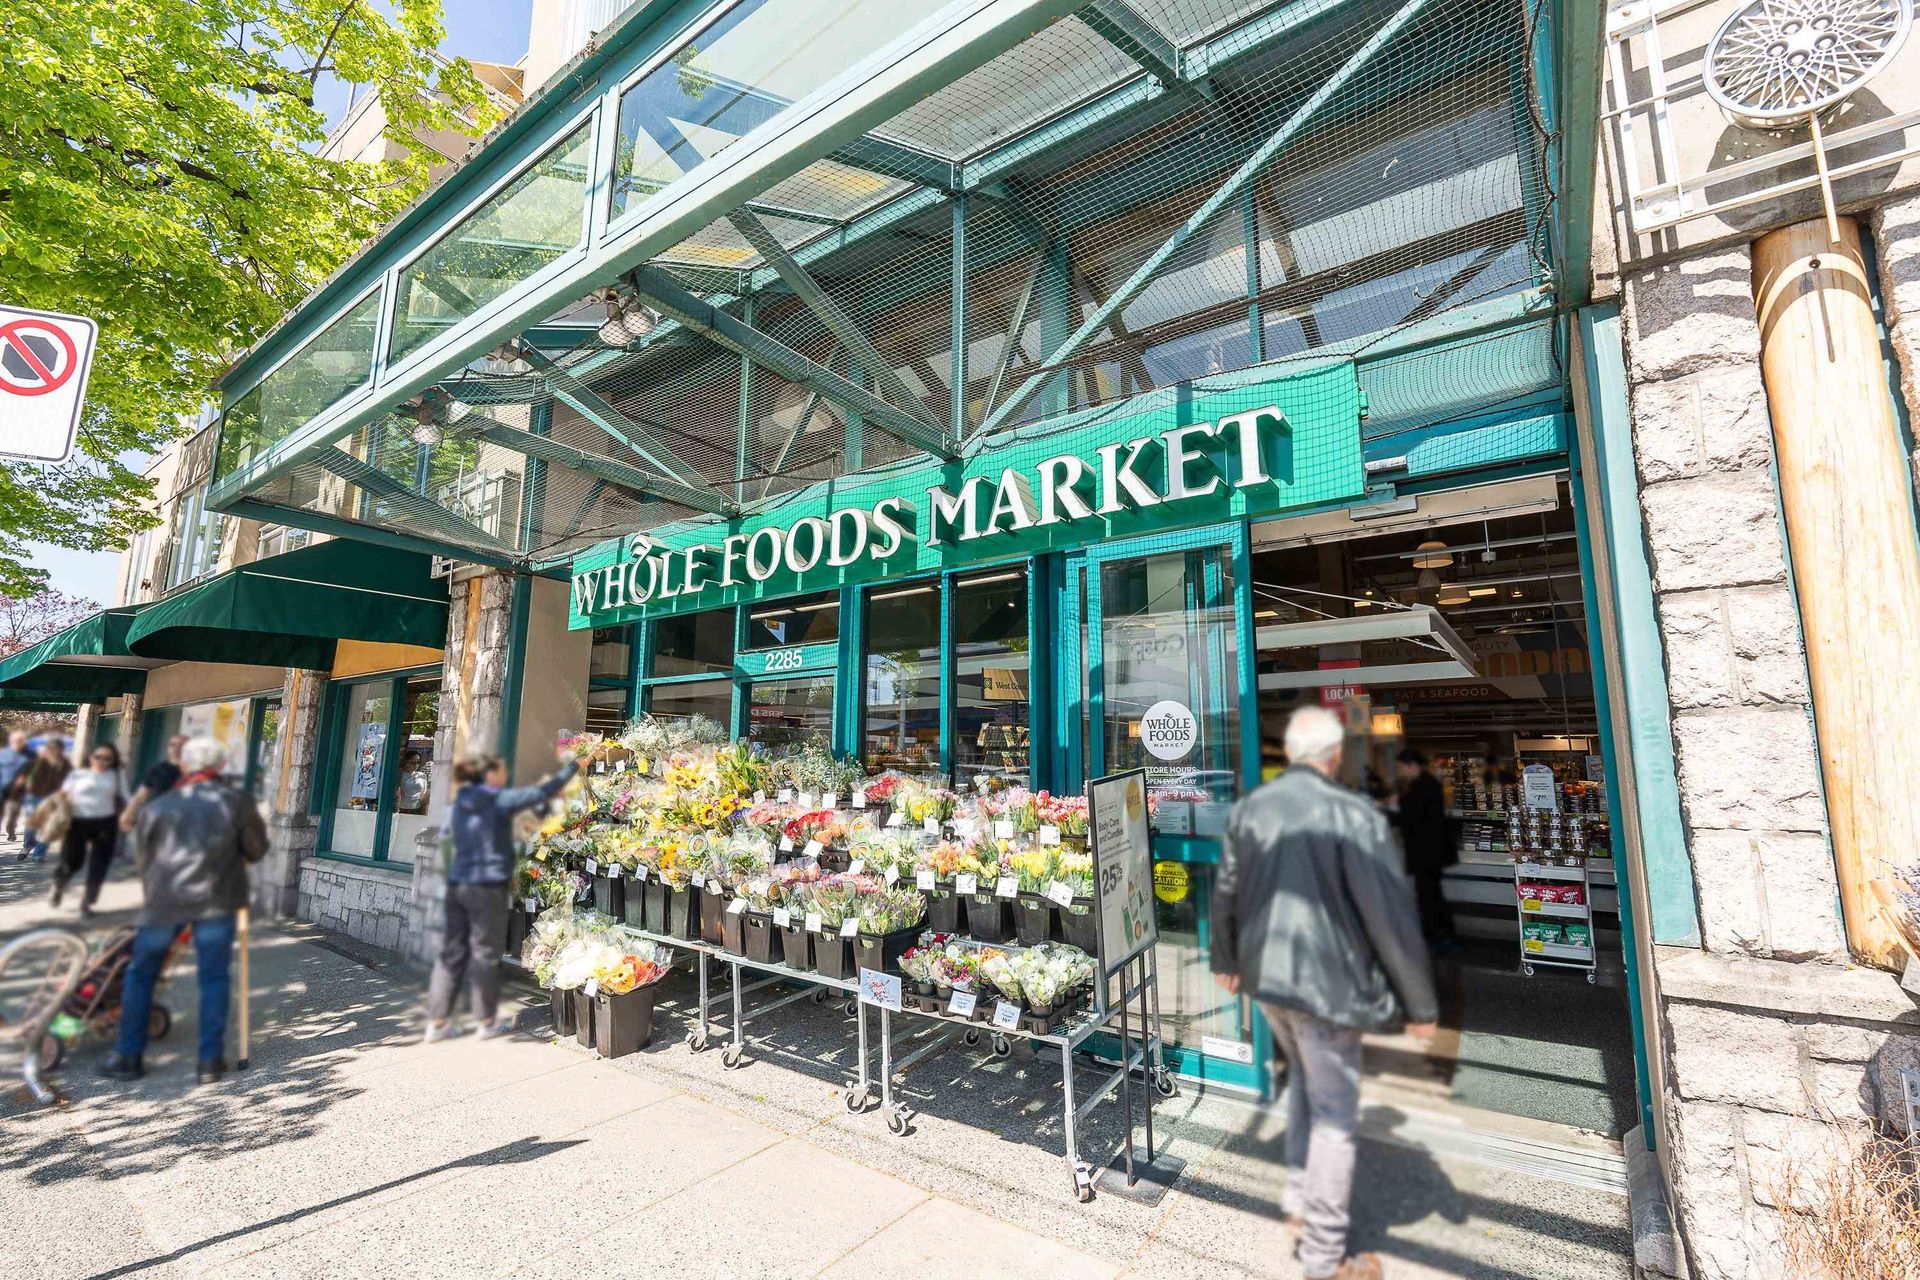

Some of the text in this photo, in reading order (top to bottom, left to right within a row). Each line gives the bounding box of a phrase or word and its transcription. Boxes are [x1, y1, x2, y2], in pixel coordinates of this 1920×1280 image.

[570, 402, 1288, 616] WHOLE FOODS MARKET
[765, 650, 802, 671] 2285
[995, 681, 1011, 690] West
[1430, 687, 1489, 697] SEAFOOD
[1146, 716, 1191, 729] WHOLE
[1149, 730, 1190, 741] FOODS
[1144, 766, 1197, 774] STORE HOURS
[1147, 789, 1154, 797] 8
[1180, 790, 1194, 798] pm
[1154, 877, 1187, 887] CAUTION
